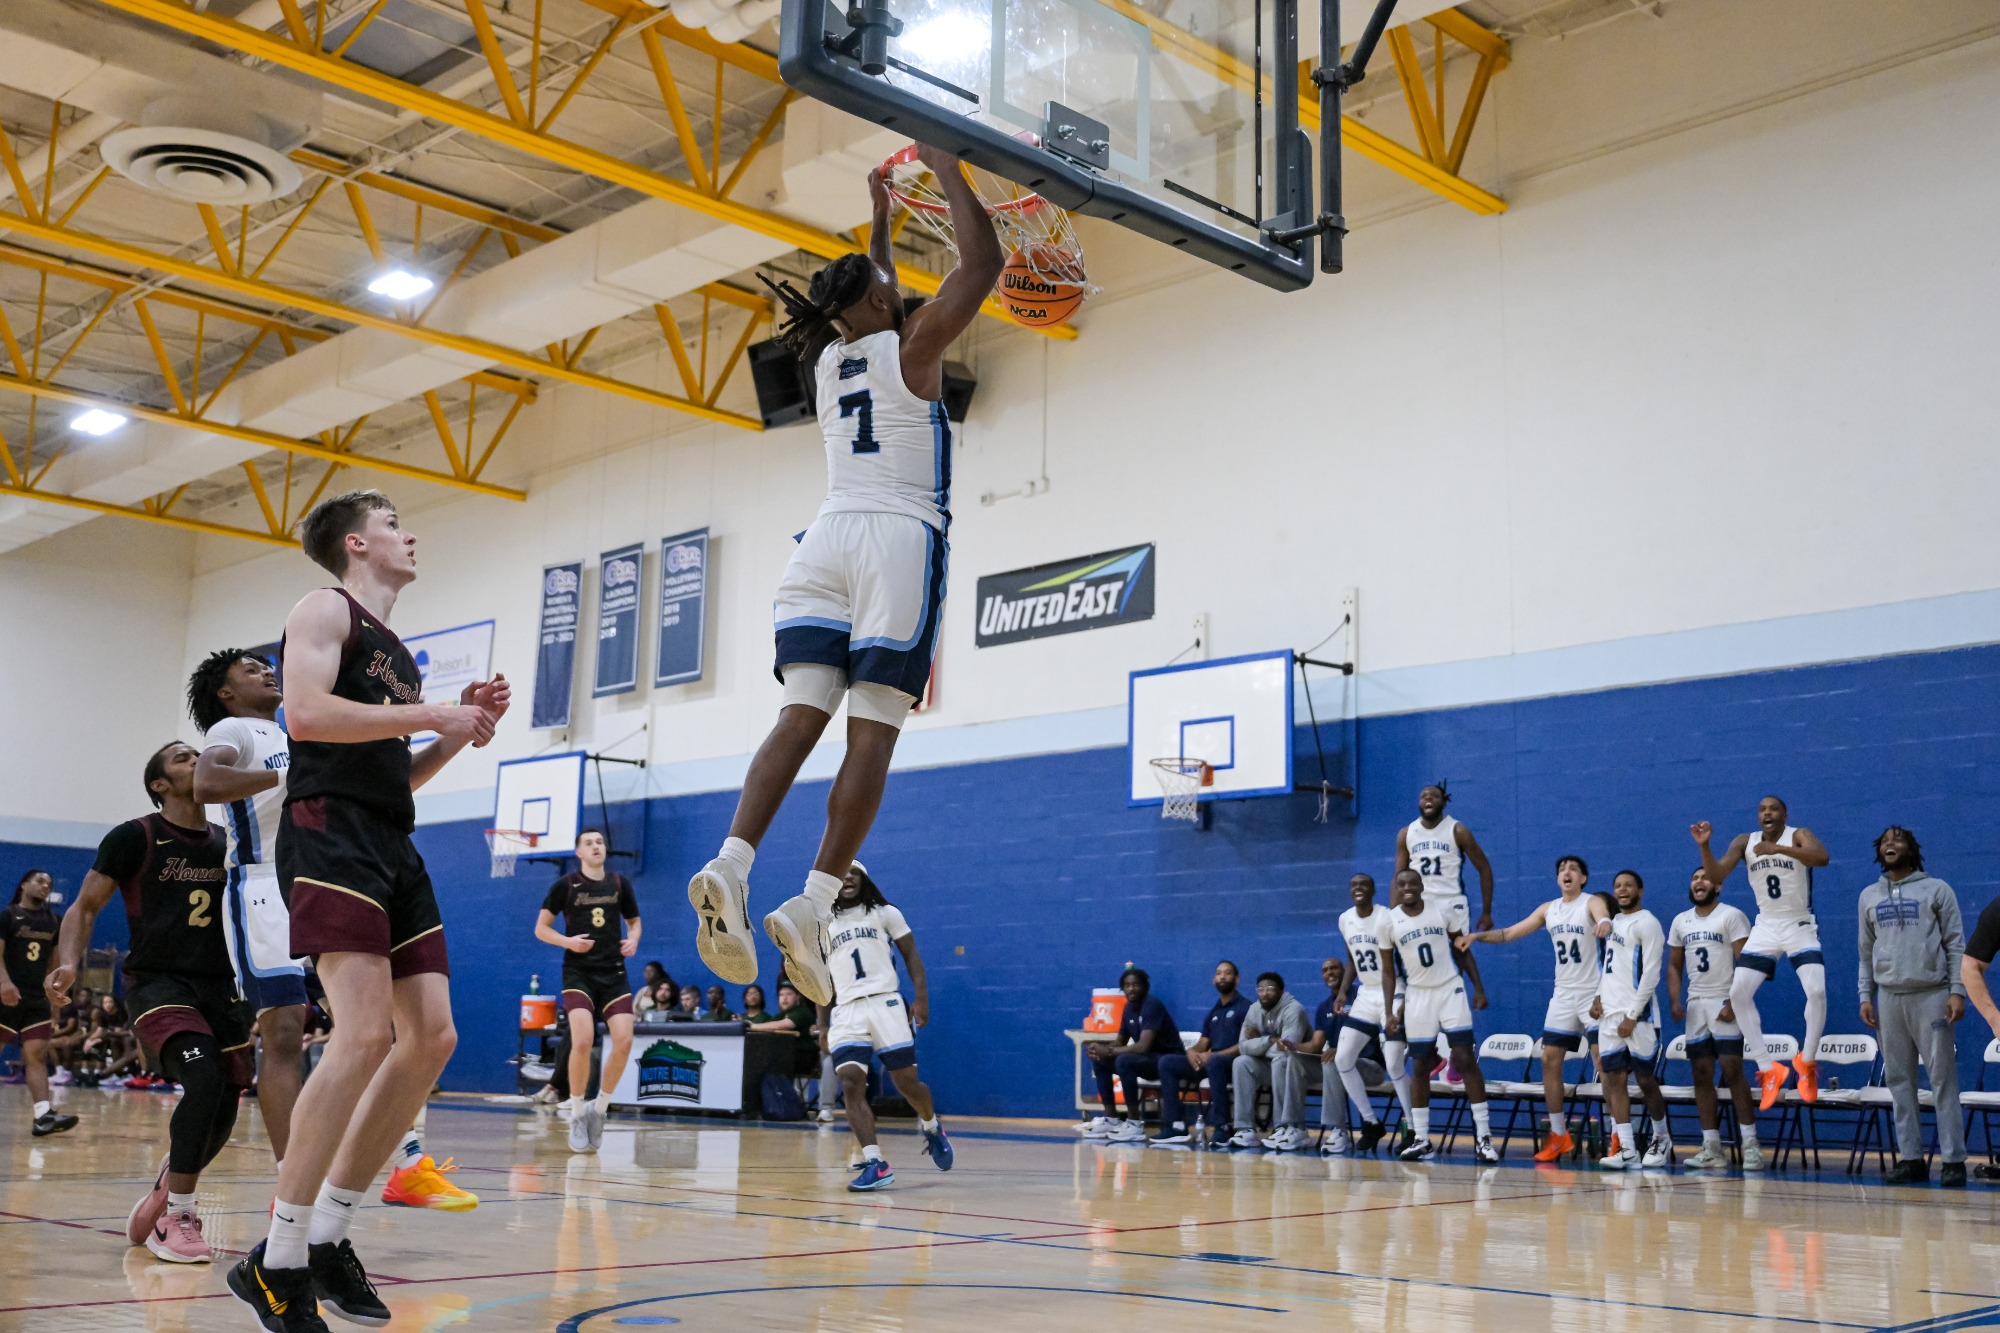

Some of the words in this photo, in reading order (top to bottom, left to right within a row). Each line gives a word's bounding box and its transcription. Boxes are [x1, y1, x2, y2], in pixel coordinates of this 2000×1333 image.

[1005, 273, 1057, 295] Wilson
[1010, 304, 1048, 318] NCAA
[838, 387, 880, 456] 7
[664, 581, 701, 597] CHAMPIONS
[602, 595, 636, 610] CHAMPIONS
[366, 649, 420, 704] Howard
[264, 752, 290, 770] NOTR
[159, 857, 227, 882] Howar
[1420, 855, 1442, 876] 21
[1750, 858, 1770, 872] NOTRE
[1772, 858, 1795, 871] DAME
[1766, 874, 1782, 899] 8
[188, 889, 213, 928] 2
[591, 907, 606, 928] 8
[855, 926, 879, 940] DAME
[1400, 928, 1421, 946] NOTRE
[1423, 926, 1444, 937] DAME
[1566, 923, 1585, 935] DAME
[1703, 931, 1724, 944] DAME
[26, 941, 41, 962] 3
[1355, 949, 1379, 972] 23
[1418, 942, 1434, 968] 0
[1556, 938, 1582, 965] 24
[1695, 946, 1710, 973] 3
[851, 947, 866, 980] 1
[1488, 1041, 1526, 1051] GATORS
[1820, 1043, 1867, 1054] GATORS
[641, 1066, 669, 1082] NOTRE
[671, 1065, 699, 1086] DAME
